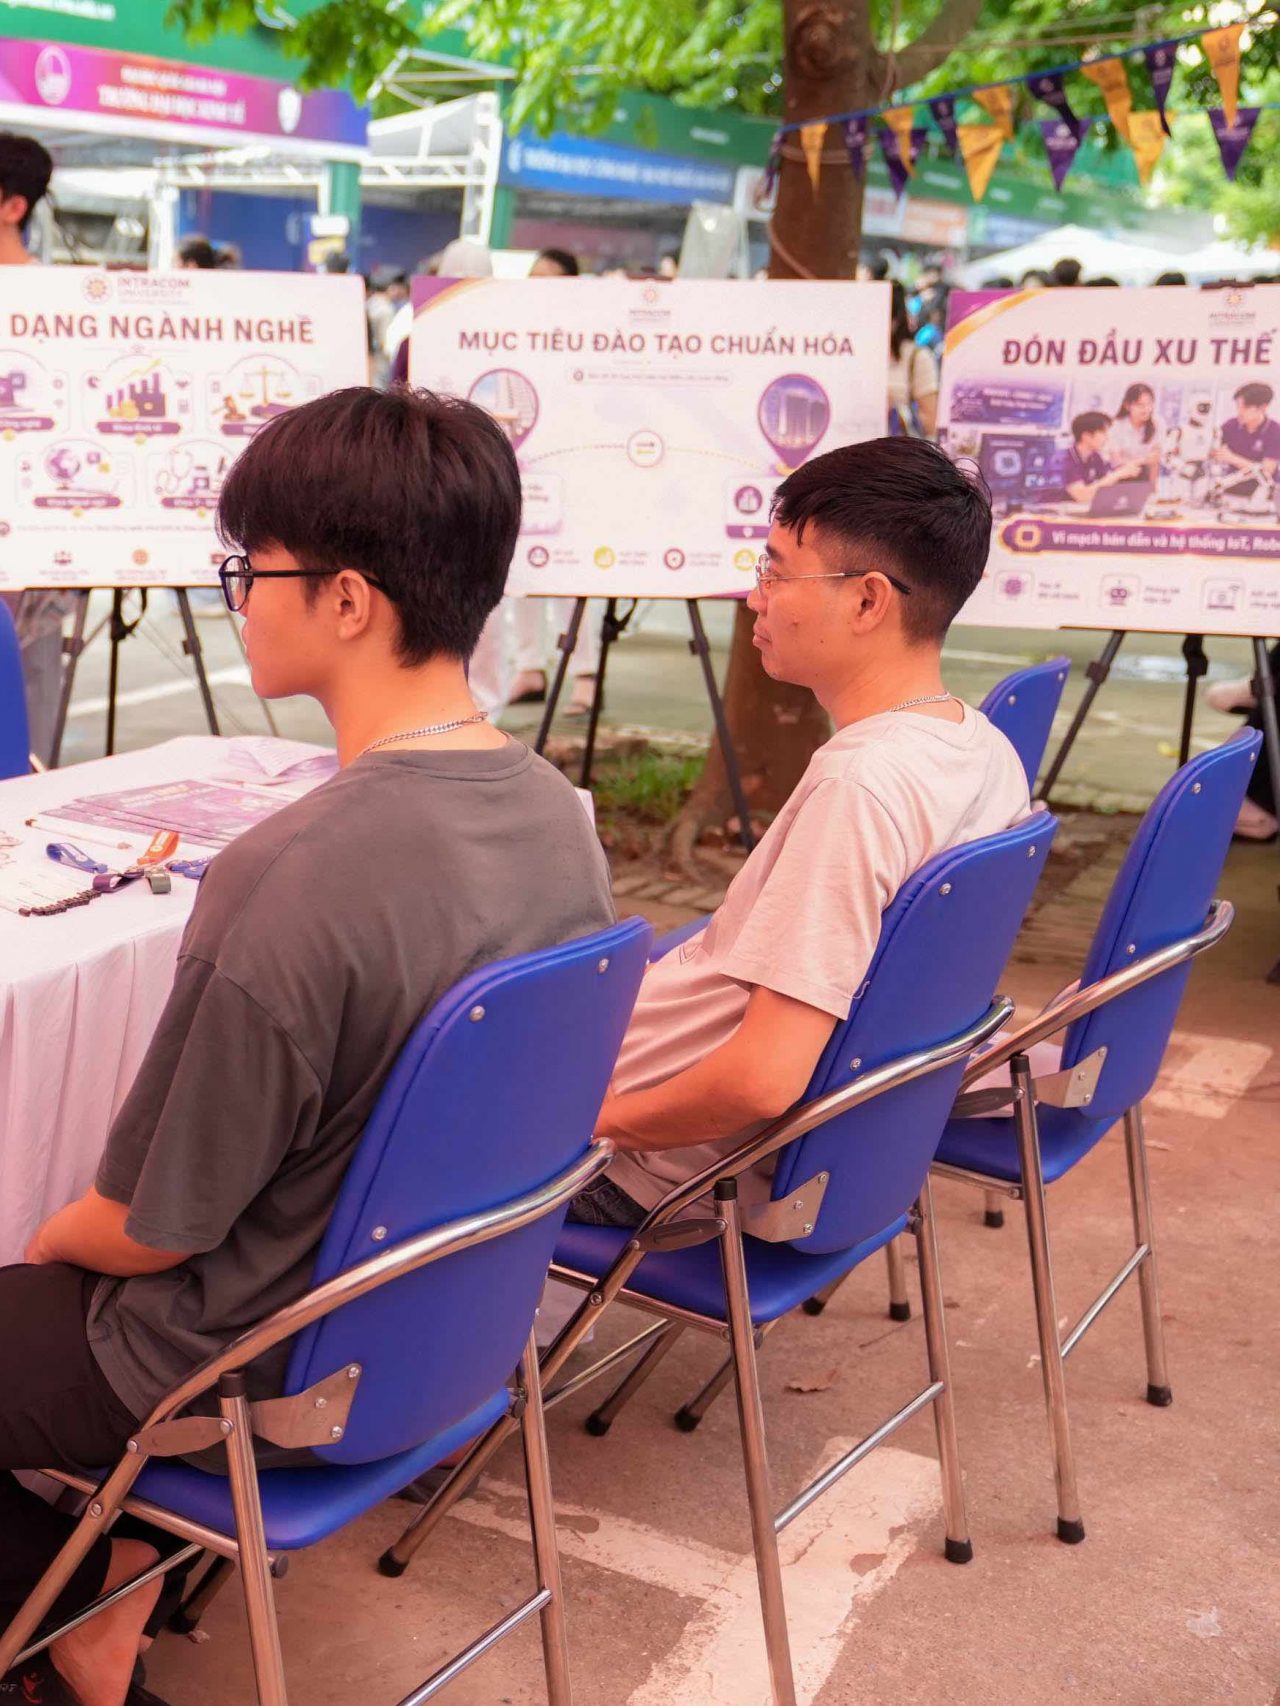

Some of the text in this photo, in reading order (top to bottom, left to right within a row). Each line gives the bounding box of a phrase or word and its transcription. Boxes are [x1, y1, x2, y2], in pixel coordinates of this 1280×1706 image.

[118, 277, 191, 290] INTRACOM
[10, 313, 99, 344] DẠNG
[110, 311, 224, 342] NGÀNH
[234, 313, 316, 344] NGHỀ
[459, 330, 518, 357] MỤC
[528, 328, 584, 352] TIÊU
[593, 328, 646, 352] ĐÀO
[655, 333, 702, 360] TẠO
[803, 331, 854, 357] HÓA
[1003, 334, 1065, 365] ĐÓN
[1154, 339, 1198, 365] XU
[1211, 329, 1278, 365] THẾ
[1052, 530, 1066, 545] Vi
[1066, 531, 1101, 548] mạch
